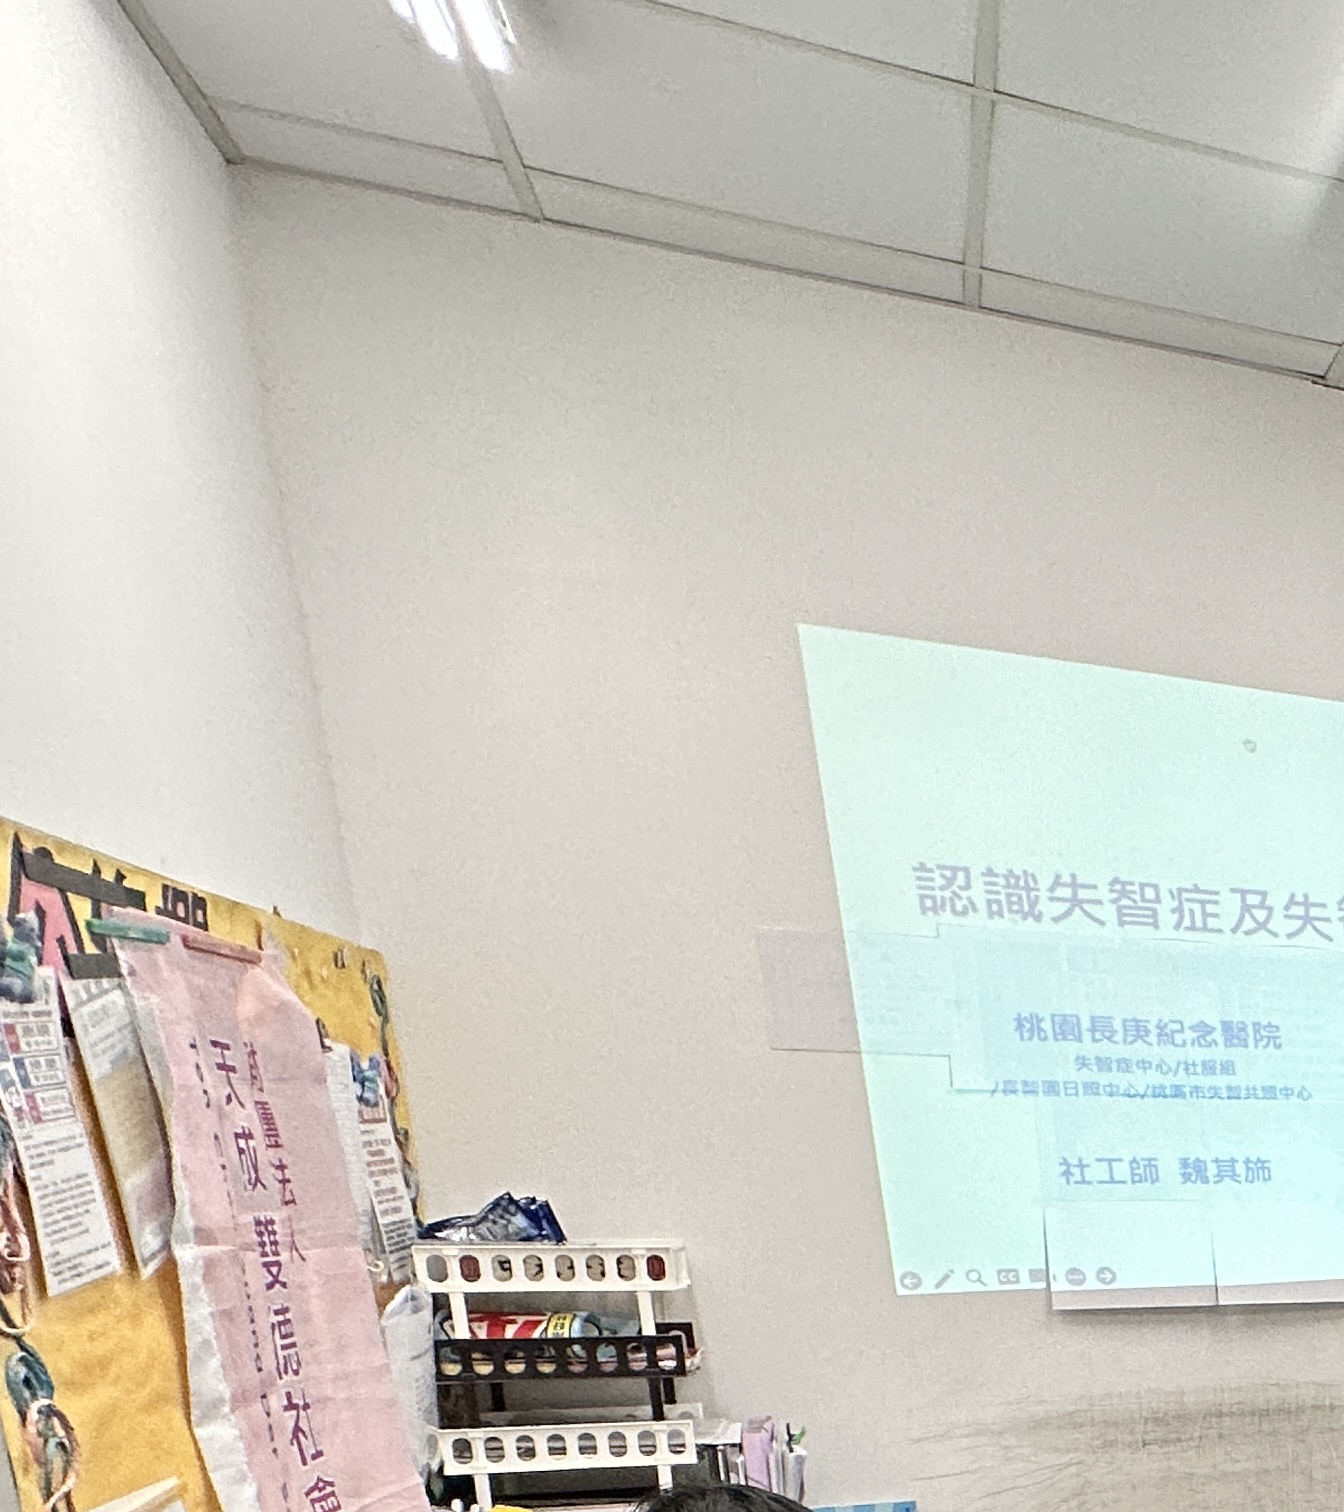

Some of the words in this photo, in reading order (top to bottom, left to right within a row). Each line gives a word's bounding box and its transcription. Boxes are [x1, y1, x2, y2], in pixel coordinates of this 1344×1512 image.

[1012, 1011, 1283, 1050] 桃園長庚紀念醫院
[1074, 1054, 1237, 1077] 失智症中心/社服組
[1059, 1156, 1161, 1186] 社工師
[1178, 1156, 1273, 1186] 魏其施
